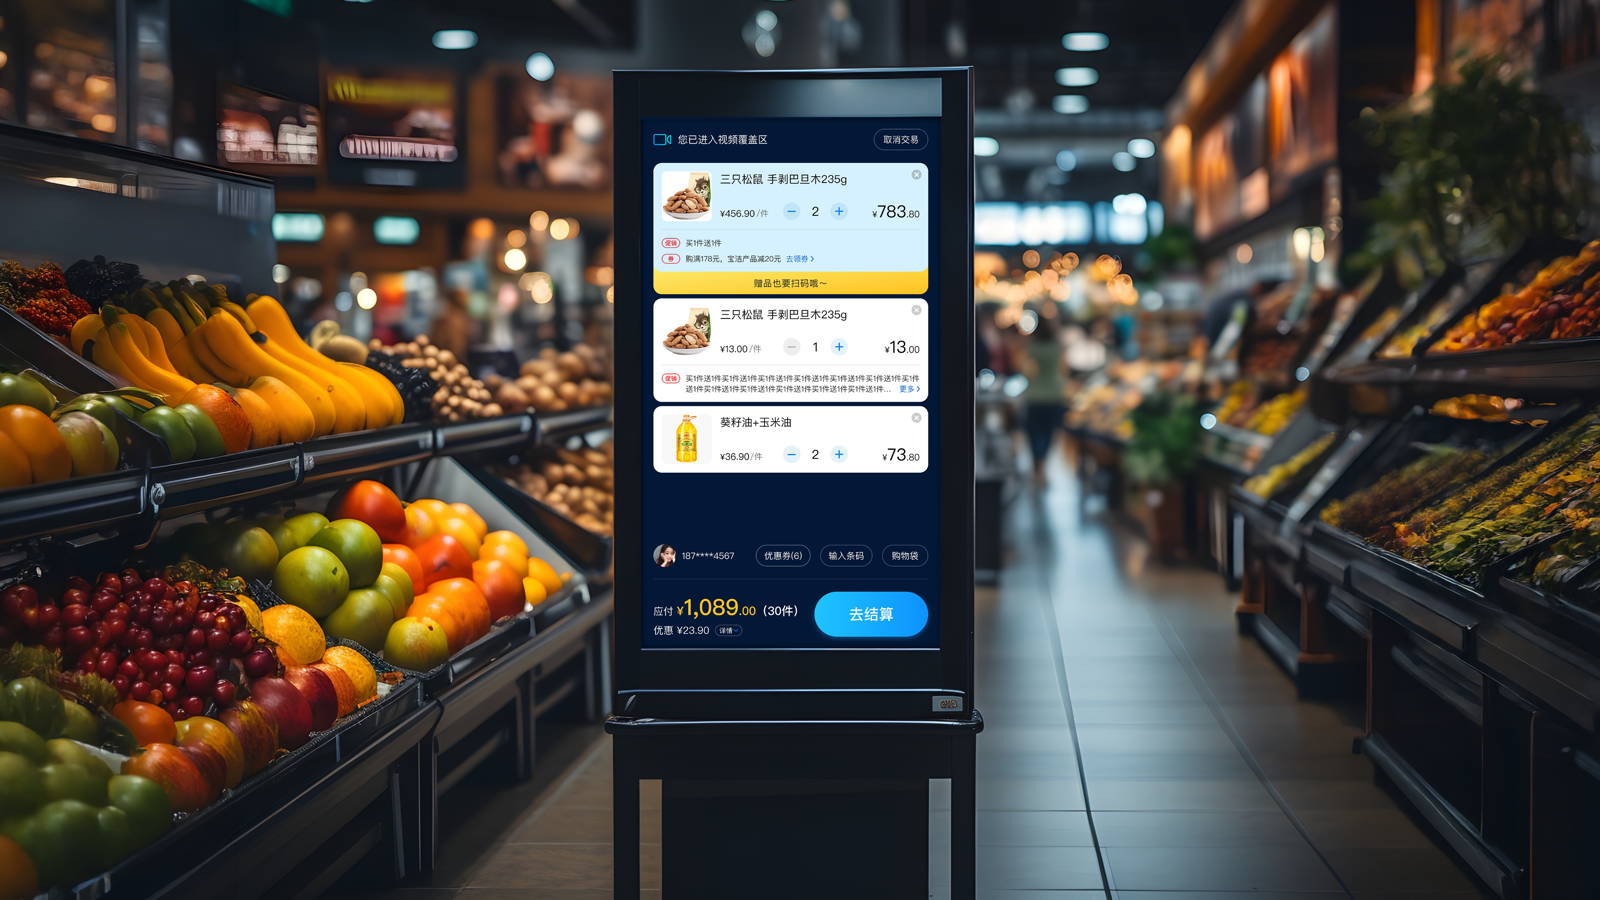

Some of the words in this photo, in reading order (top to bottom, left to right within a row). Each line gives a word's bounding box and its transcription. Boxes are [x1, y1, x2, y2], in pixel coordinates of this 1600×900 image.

[678, 135, 767, 144] 您已进入视频覆盖区
[884, 135, 918, 144] 取消交易
[720, 174, 763, 185] 三只松鼠
[767, 174, 847, 186] 手剥巴旦木235g
[812, 206, 819, 216] 2
[873, 205, 920, 218] ¥783.80
[686, 239, 721, 247] 买1件送1件
[720, 309, 763, 320] 三只松鼠
[767, 309, 847, 321] 手剥巴旦木235g
[812, 342, 818, 352] 1
[885, 340, 920, 353] ¥13.00
[900, 385, 914, 393] 更多
[721, 417, 791, 427] 葵籽油+玉米油
[812, 449, 819, 459] 2
[882, 448, 920, 461] ¥73.80
[764, 551, 802, 560] 优惠券(6)
[829, 551, 864, 560] 输入条码
[892, 551, 918, 560] 购物袋
[654, 606, 673, 616] 应付
[677, 599, 756, 619] ¥1,089.00
[850, 607, 893, 621] 去结算
[654, 626, 673, 635] 优惠
[677, 626, 709, 634] ¥23.90
